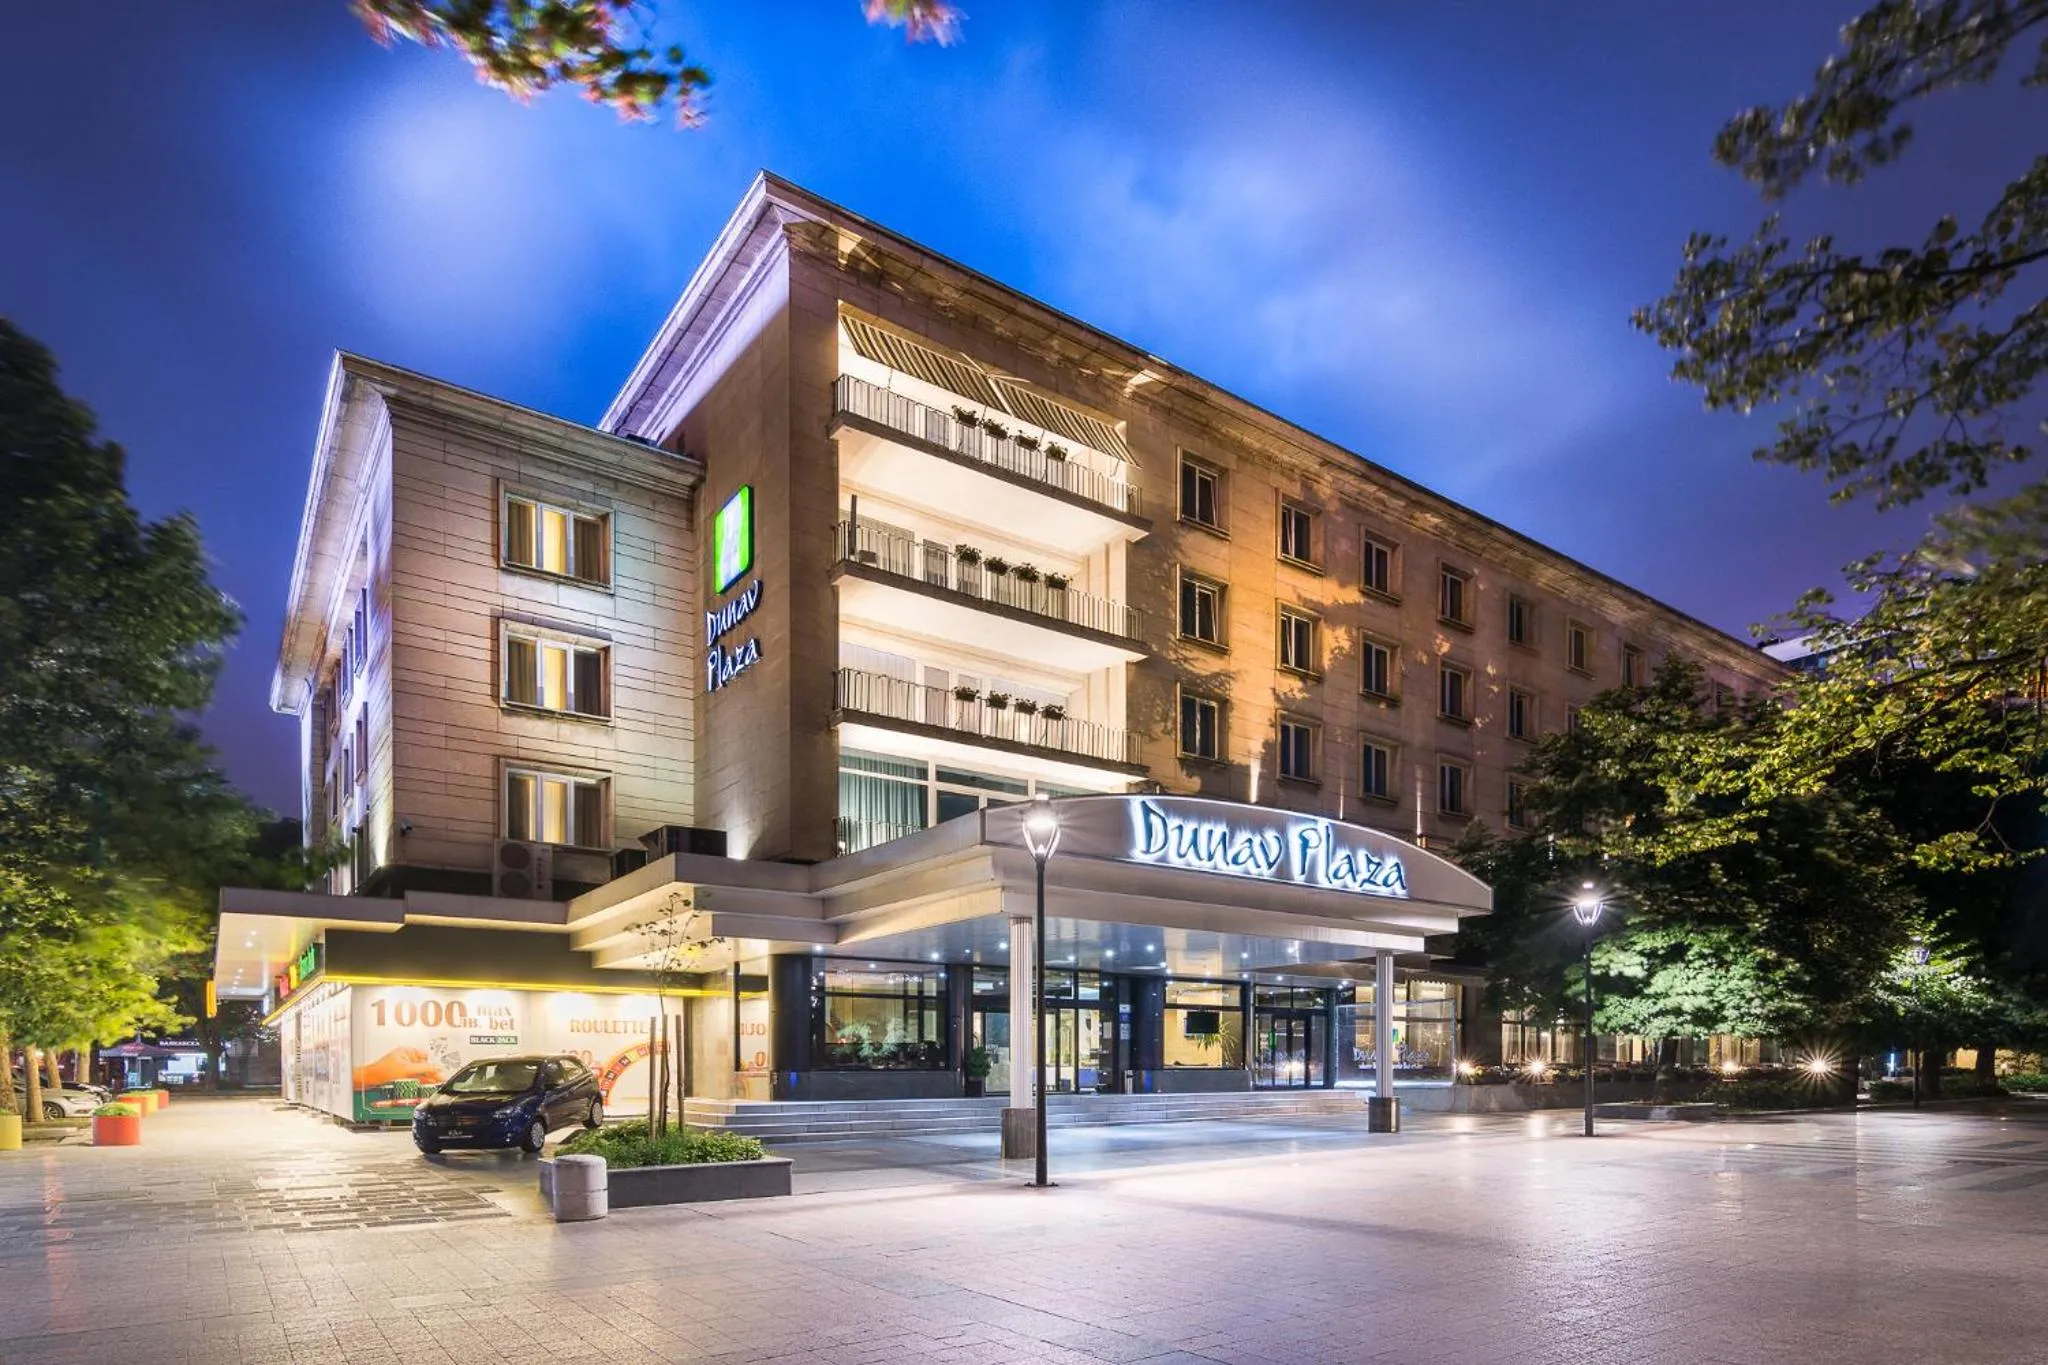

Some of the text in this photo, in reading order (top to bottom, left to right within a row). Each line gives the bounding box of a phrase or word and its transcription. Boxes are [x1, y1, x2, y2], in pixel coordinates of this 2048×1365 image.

[706, 579, 762, 647] Dunav
[707, 638, 759, 692] Plaza
[1135, 799, 1407, 891] Dunav Plaza
[371, 999, 467, 1028] 1000
[477, 1005, 513, 1017] max
[489, 1017, 515, 1031] bet
[569, 1018, 649, 1034] ROULETTE
[470, 1035, 496, 1045] BLACK
